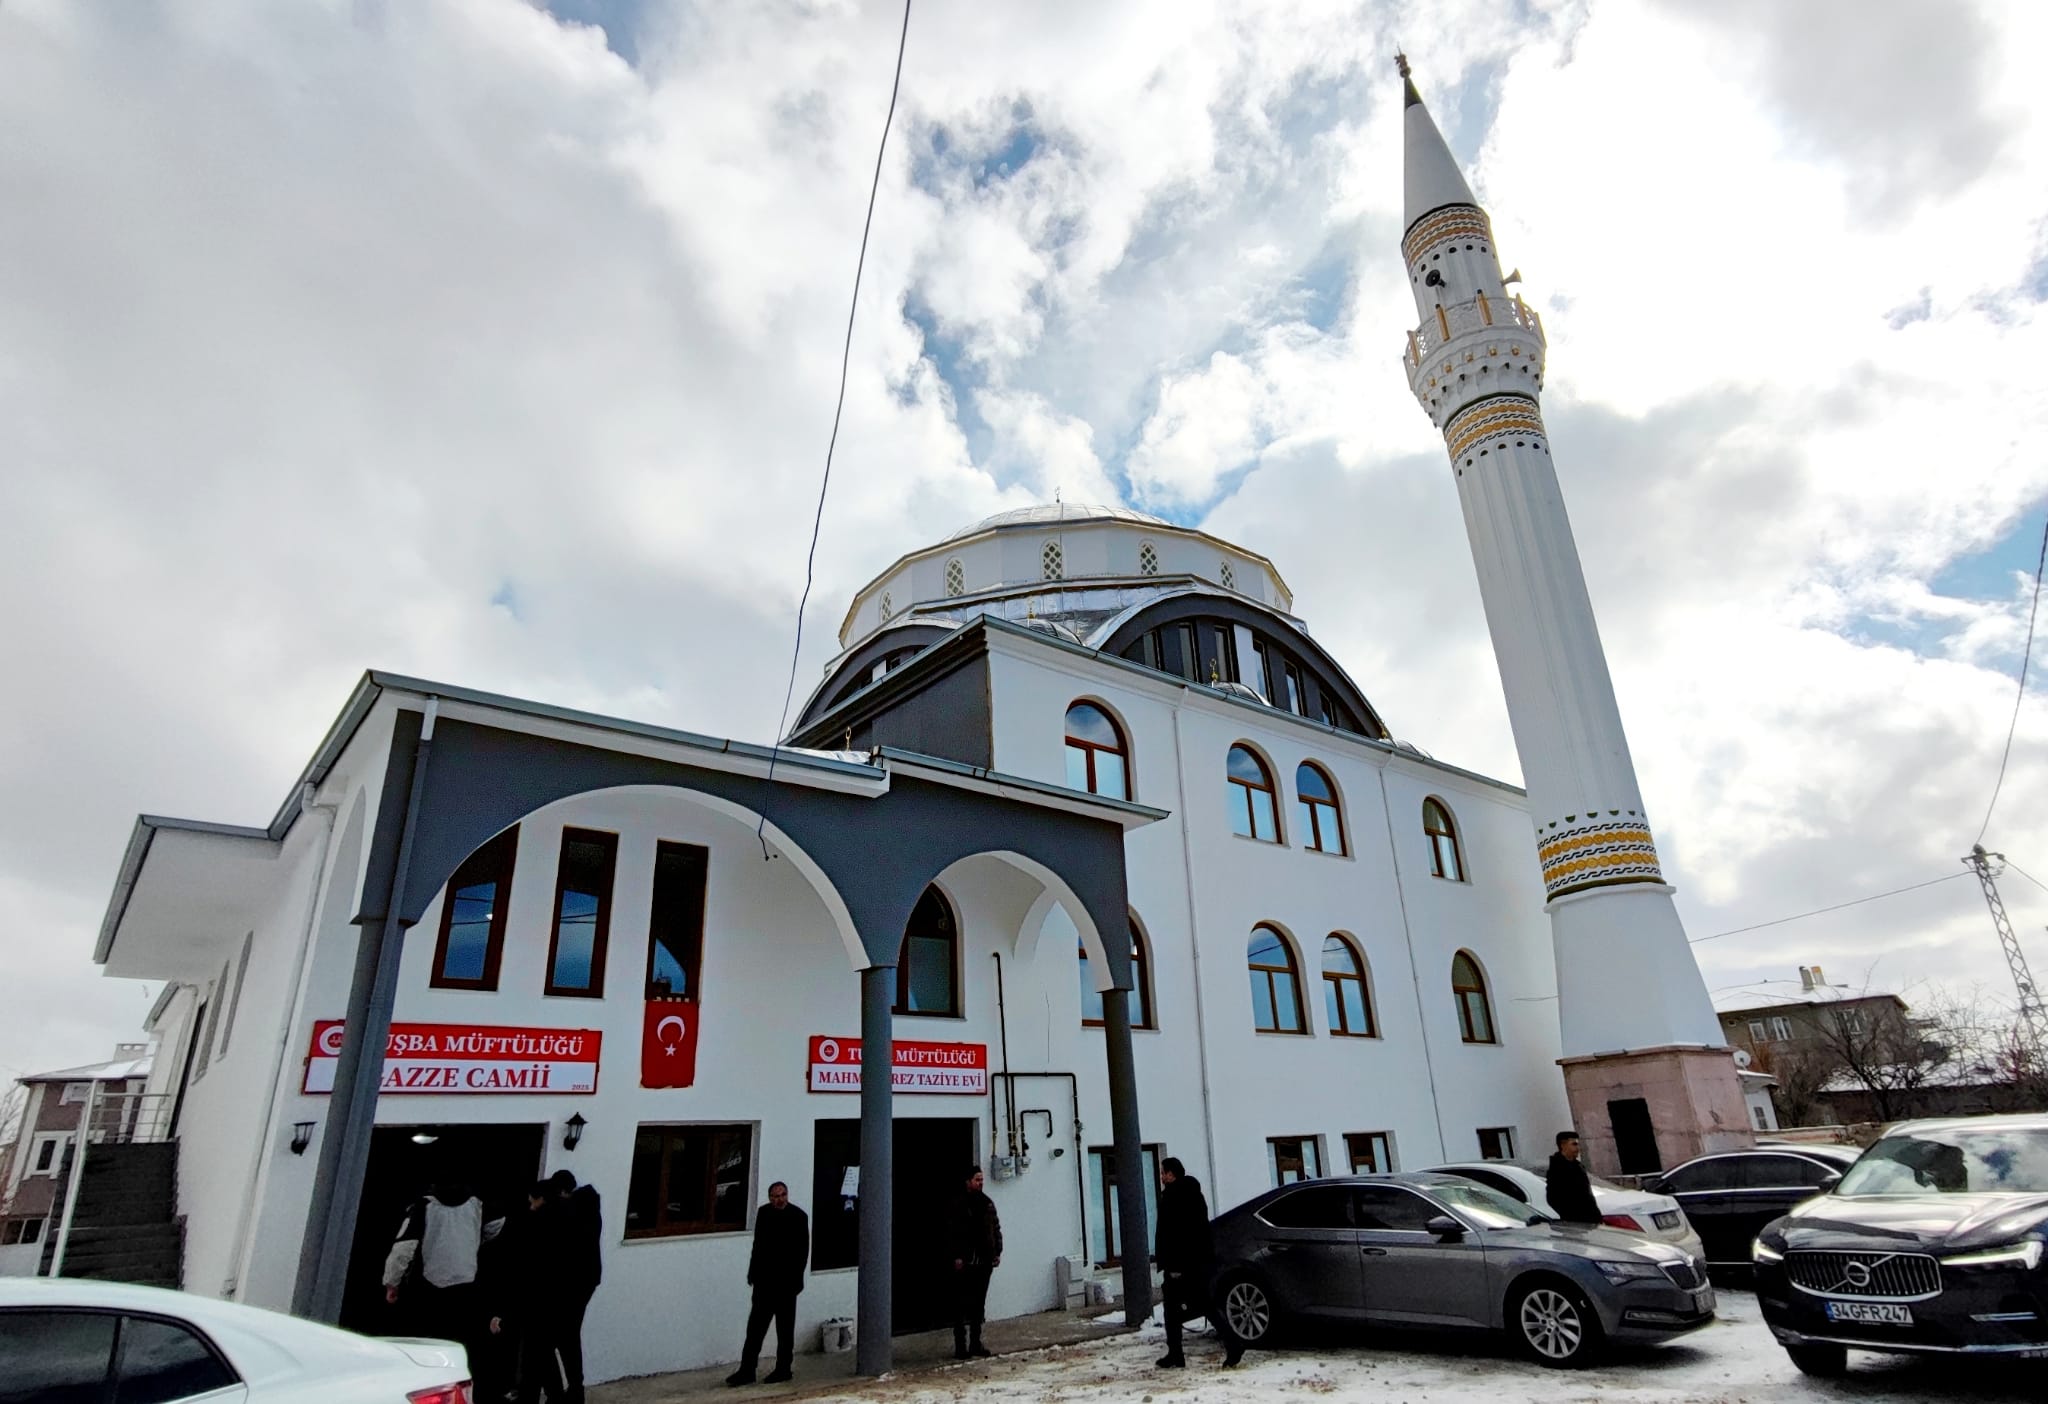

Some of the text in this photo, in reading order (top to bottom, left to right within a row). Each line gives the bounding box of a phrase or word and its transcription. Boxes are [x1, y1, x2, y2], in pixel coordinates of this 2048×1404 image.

[386, 1032, 584, 1056] ŞBA MÜFTÜLÜĞÜ
[896, 1047, 977, 1065] MÜFTÜLÜĞÜ
[381, 1064, 552, 1088] AZZE CAMİİ
[819, 1071, 982, 1087] MAHM REZ TAZİYE EVİ
